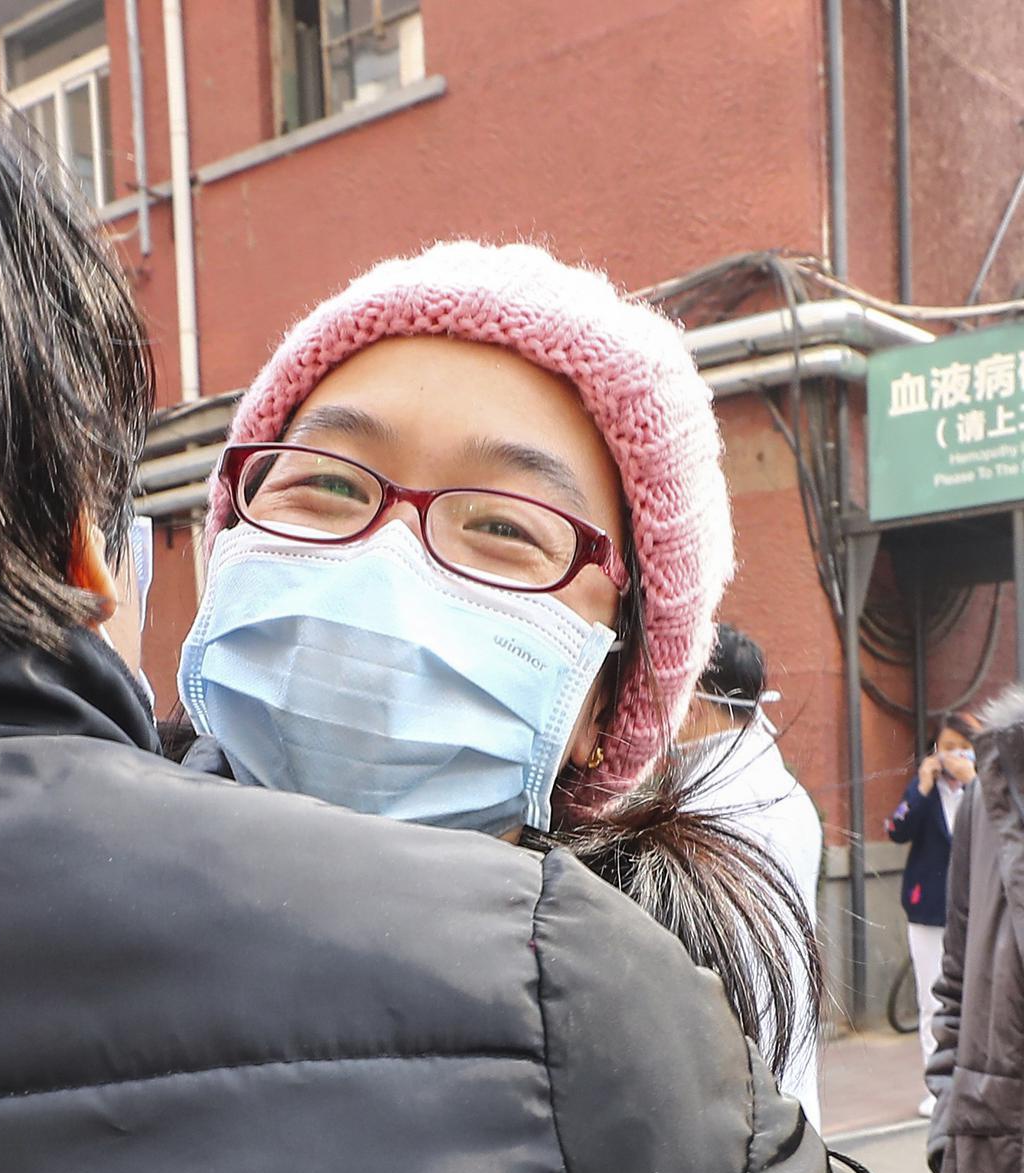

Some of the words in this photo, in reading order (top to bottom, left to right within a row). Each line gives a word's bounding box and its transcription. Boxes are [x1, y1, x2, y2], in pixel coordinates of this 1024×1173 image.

[888, 351, 1024, 416] 血液病
[936, 403, 1024, 449] （请上
[934, 471, 975, 487] Please
[978, 466, 992, 479] To
[995, 463, 1019, 476] The
